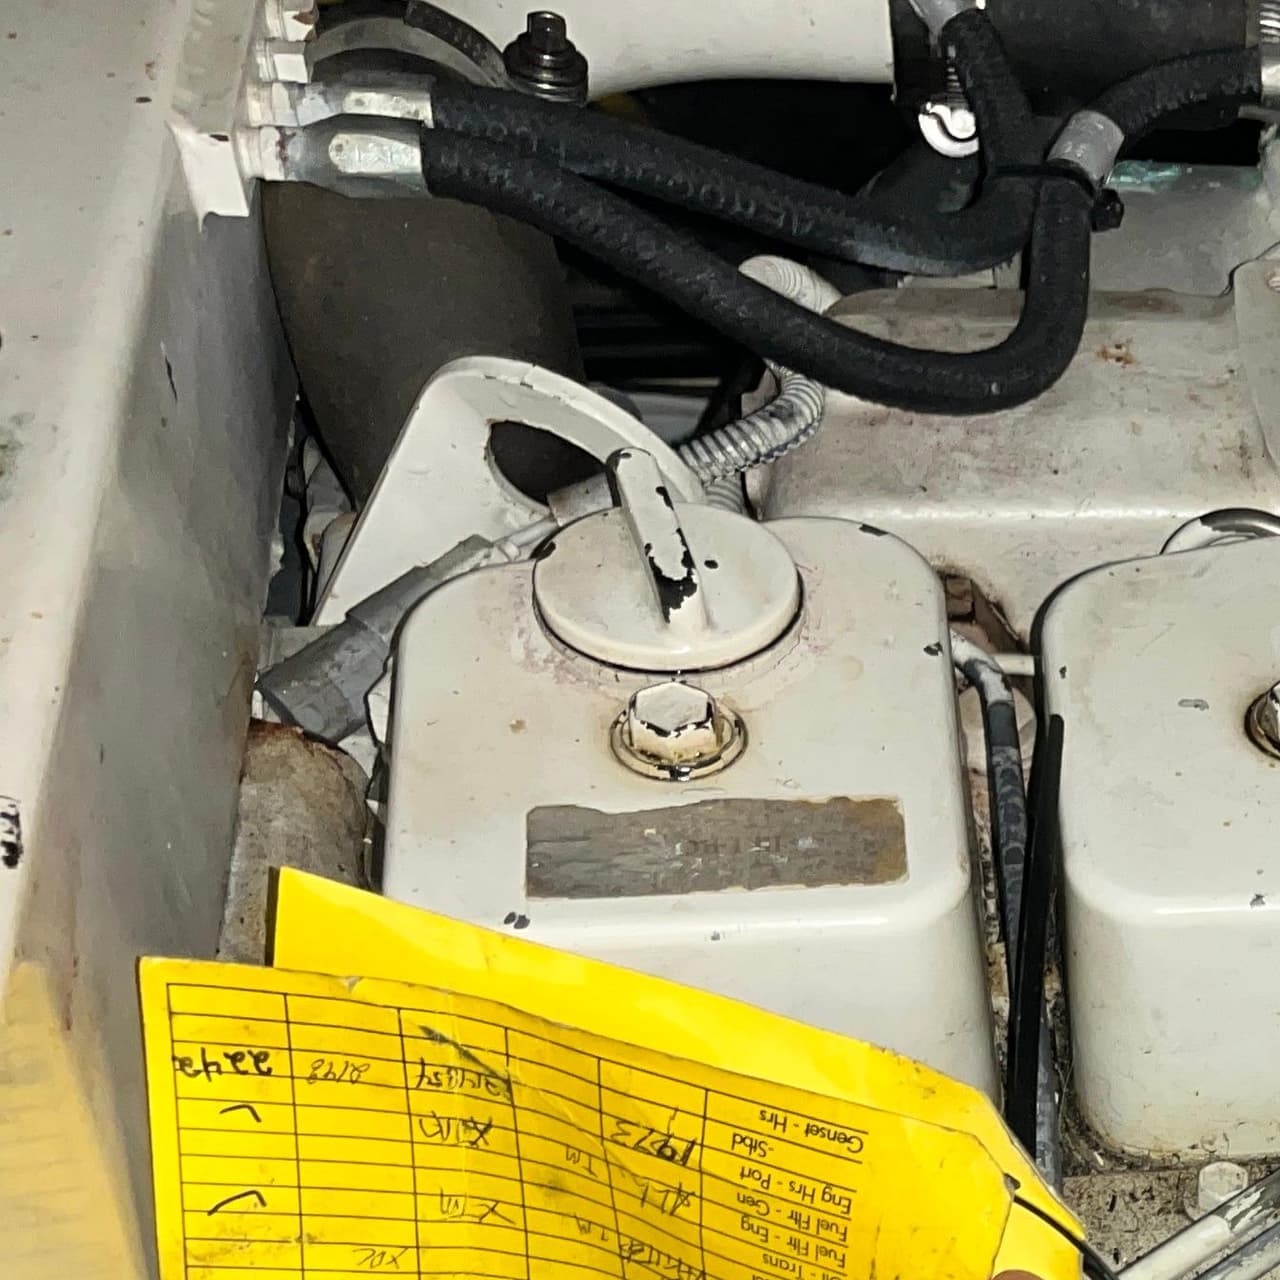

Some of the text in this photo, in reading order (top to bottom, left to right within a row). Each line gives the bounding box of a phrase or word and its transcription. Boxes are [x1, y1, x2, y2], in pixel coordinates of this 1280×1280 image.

[171, 1048, 272, 1081] 2242
[758, 1109, 787, 1132] Hrs
[731, 1132, 772, 1158] -Stbd
[804, 1121, 863, 1154] Genset
[739, 1165, 771, 1188] Port
[736, 1192, 770, 1217] Gen
[788, 1181, 815, 1204] Hrs
[821, 1185, 850, 1215] Eng
[740, 1214, 768, 1241] Eng
[787, 1209, 811, 1230] Fltr
[816, 1219, 847, 1242] Fuel
[786, 1235, 808, 1256] Fltr
[815, 1245, 845, 1267] Fuel
[763, 1253, 802, 1280] Trans
